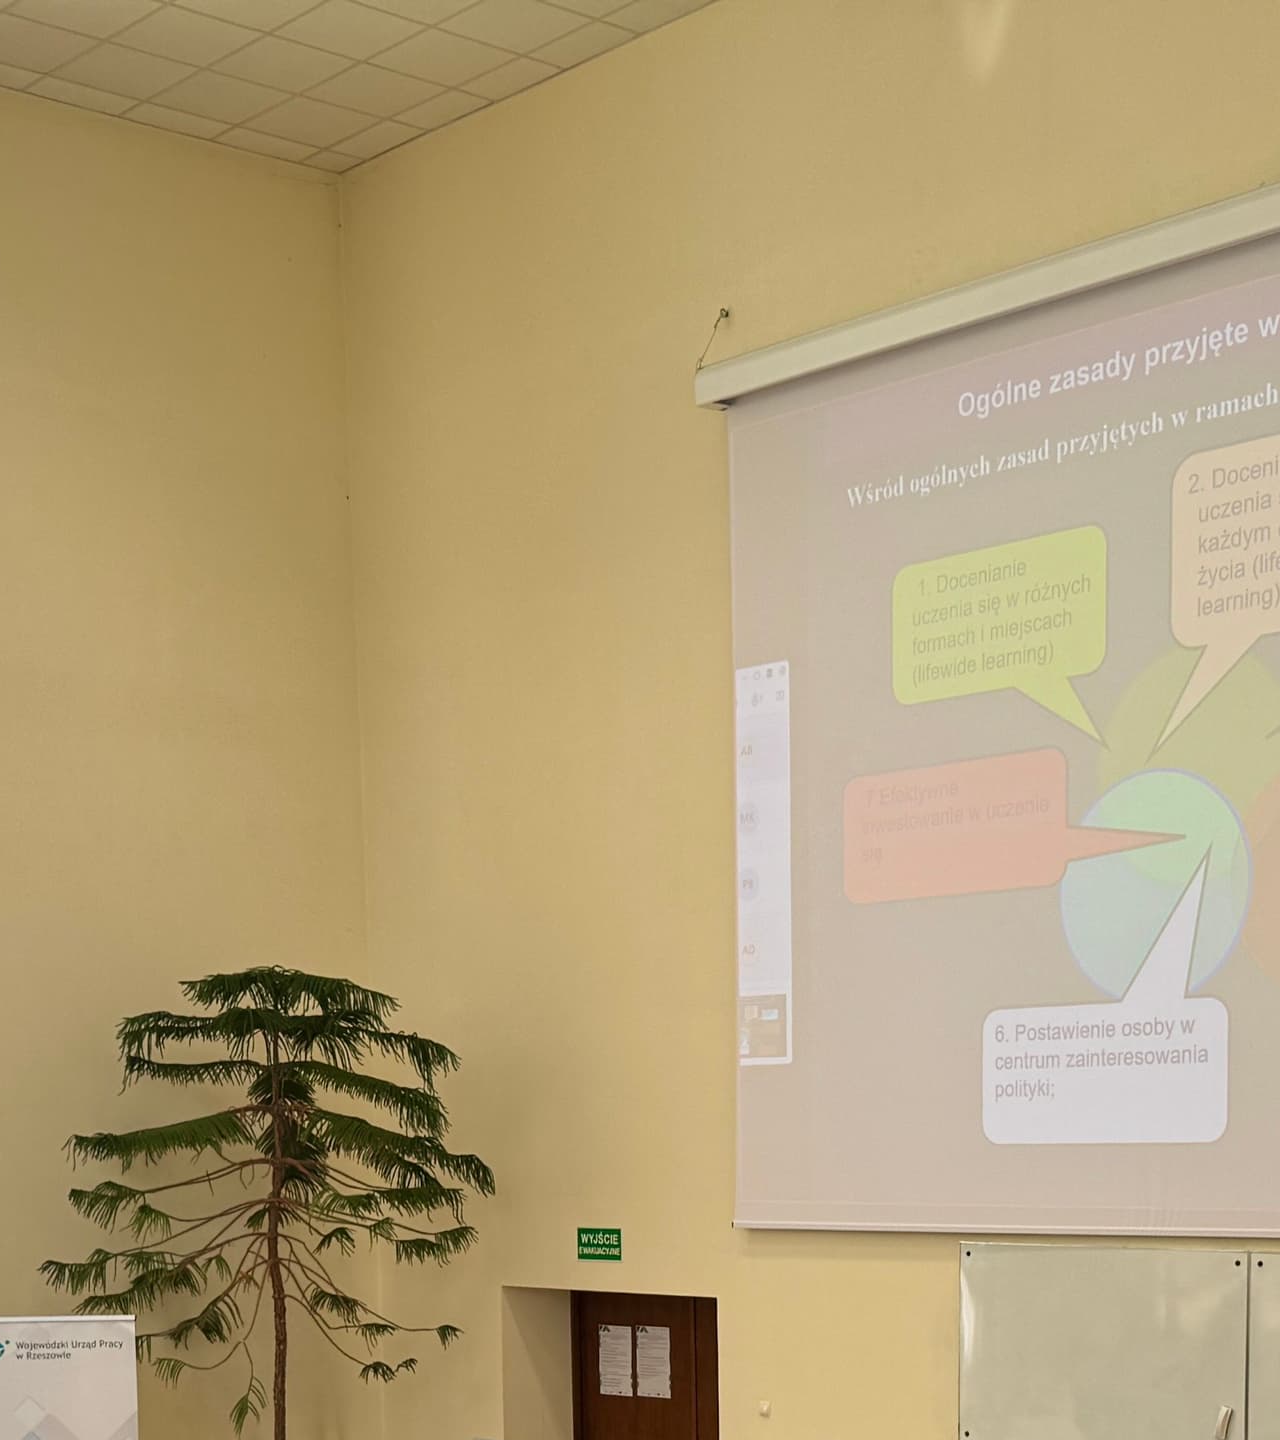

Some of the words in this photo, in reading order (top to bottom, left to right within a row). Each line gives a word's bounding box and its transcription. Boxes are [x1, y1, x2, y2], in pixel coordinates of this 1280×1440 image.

[958, 376, 1042, 418] Ogólne
[1049, 351, 1135, 393] zasady
[1145, 320, 1249, 379] przyjęte
[1259, 315, 1280, 337] w
[846, 478, 904, 508] Wśród
[910, 455, 990, 497] ogólnych
[997, 439, 1049, 472] zasad
[1056, 412, 1164, 463] przyjętych
[1171, 411, 1189, 430] w
[1196, 388, 1279, 423] ramach
[1188, 473, 1205, 494] 2.
[1198, 491, 1272, 523] uczenia
[1198, 525, 1271, 554] każdym
[936, 560, 1026, 593] Docenianie
[1197, 560, 1246, 589] życia
[912, 600, 973, 627] uczenia
[978, 594, 1001, 616] się
[1006, 592, 1021, 608] w
[1024, 574, 1091, 605] różnych
[912, 631, 976, 656] formach
[990, 608, 1073, 642] miejscach
[912, 656, 977, 688] (lifewide
[981, 641, 1054, 672] learning)
[994, 1025, 1009, 1043] 6.
[1015, 1020, 1116, 1042] Postawienie
[1122, 1017, 1175, 1039] osoby
[1181, 1018, 1195, 1034] w
[995, 1053, 1060, 1070] centrum
[1066, 1044, 1209, 1068] zainteresowania
[995, 1079, 1055, 1102] polityki;
[581, 1231, 619, 1245] WYJŚCIE
[15, 1340, 69, 1352] Wojewódzki
[71, 1340, 97, 1351] Urząd
[99, 1339, 123, 1350] Pracy
[26, 1351, 72, 1361] Rzeszowie
